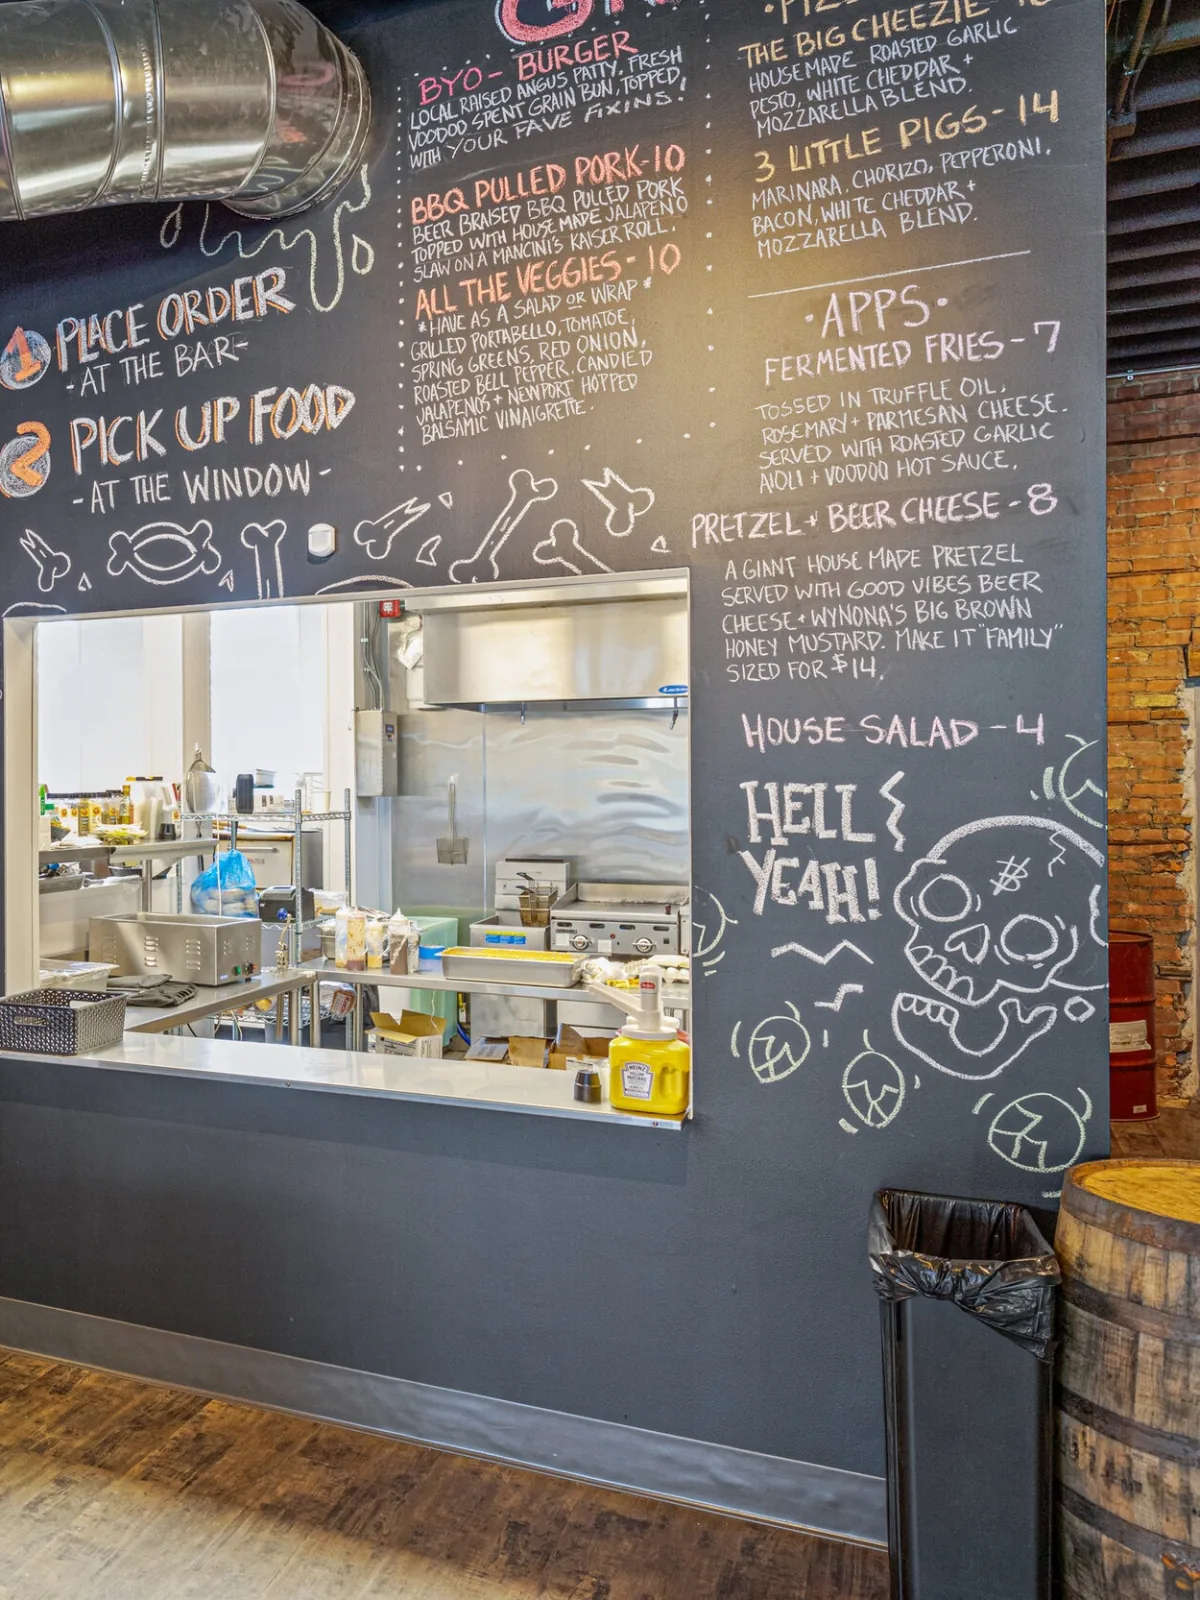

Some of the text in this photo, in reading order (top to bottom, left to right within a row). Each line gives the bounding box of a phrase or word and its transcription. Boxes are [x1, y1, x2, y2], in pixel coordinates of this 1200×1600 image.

[517, 30, 638, 81] BURGER
[738, 40, 789, 68] THE
[796, 26, 846, 57] BIG
[852, 0, 990, 41] CHEEZIE
[870, 16, 1017, 64] ROASTED GARLIC
[410, 45, 683, 130] LOCAL RAISED ANGUS FRESH
[472, 101, 525, 130] SPENT
[528, 87, 577, 117] GRAIN
[620, 66, 680, 98] TOPPED
[807, 77, 861, 102] WHITE
[866, 55, 960, 89] CHEDDAR
[410, 146, 441, 169] WITH
[446, 128, 508, 159] YOUR
[512, 111, 573, 139] FAVE
[756, 98, 878, 139] MOZZARELLA
[755, 151, 776, 183] 3
[790, 127, 881, 171] LITTLE
[852, 158, 934, 190] CHORIZO,
[410, 163, 567, 226] BBQ PULLED
[412, 175, 685, 246] BEER BRAISED BBQ PULLED PORK
[751, 181, 965, 238] BACON, WHITE CHEDDAR
[410, 195, 689, 266] TOPPED WITH HOUSE MADE JALAPENO
[412, 224, 622, 285] SLAW ON A MANCINI'S KAISER
[757, 218, 888, 260] MOZZARELLA
[55, 303, 151, 372] PLACE
[158, 266, 297, 340] ORDER
[415, 287, 459, 321] ALL
[458, 271, 513, 307] THE
[471, 291, 587, 329] AS A SALAD OR
[411, 336, 467, 361] GRILLED
[471, 320, 562, 351] PORTABELLO,
[412, 326, 646, 383] SPRING GREENS, RED ONION,
[764, 340, 912, 387] FERMENTED
[120, 351, 163, 386] THE
[414, 350, 653, 404] ROASTED BELL CANDIED
[507, 378, 574, 405] NEWPORT
[581, 373, 638, 395] HOPPED
[754, 379, 952, 421] TOSSED IN TRUFFLE
[69, 408, 167, 476] PICK
[175, 396, 241, 452] UP
[249, 383, 356, 445] FOOD
[422, 416, 489, 446] BALSAMIC
[759, 422, 1055, 470] SERVED WITH ROASTED GARLIC
[762, 404, 969, 446] ROSEMARY PARMESAN
[130, 473, 171, 505] THE
[759, 457, 936, 495] AIOLI VOODOO HOT
[691, 511, 805, 549] PRETZEL
[827, 500, 898, 533] BEER
[724, 543, 1025, 581] A GIANT HOUSE MADE PRETZEL
[721, 570, 1044, 607] SERVED WITH GOOD VIBES BEER
[722, 596, 1033, 635] CHEESE WYNONA'S BIG BROWN
[725, 637, 778, 659] HONEY
[788, 632, 885, 655] MUSTARD.
[895, 627, 947, 652] MAKE
[953, 628, 976, 648] IT
[726, 661, 780, 682] SIZED
[787, 659, 828, 681] FOR
[741, 713, 845, 754] HOUSE
[739, 780, 876, 846] HELL
[736, 847, 882, 925] YEAH!
